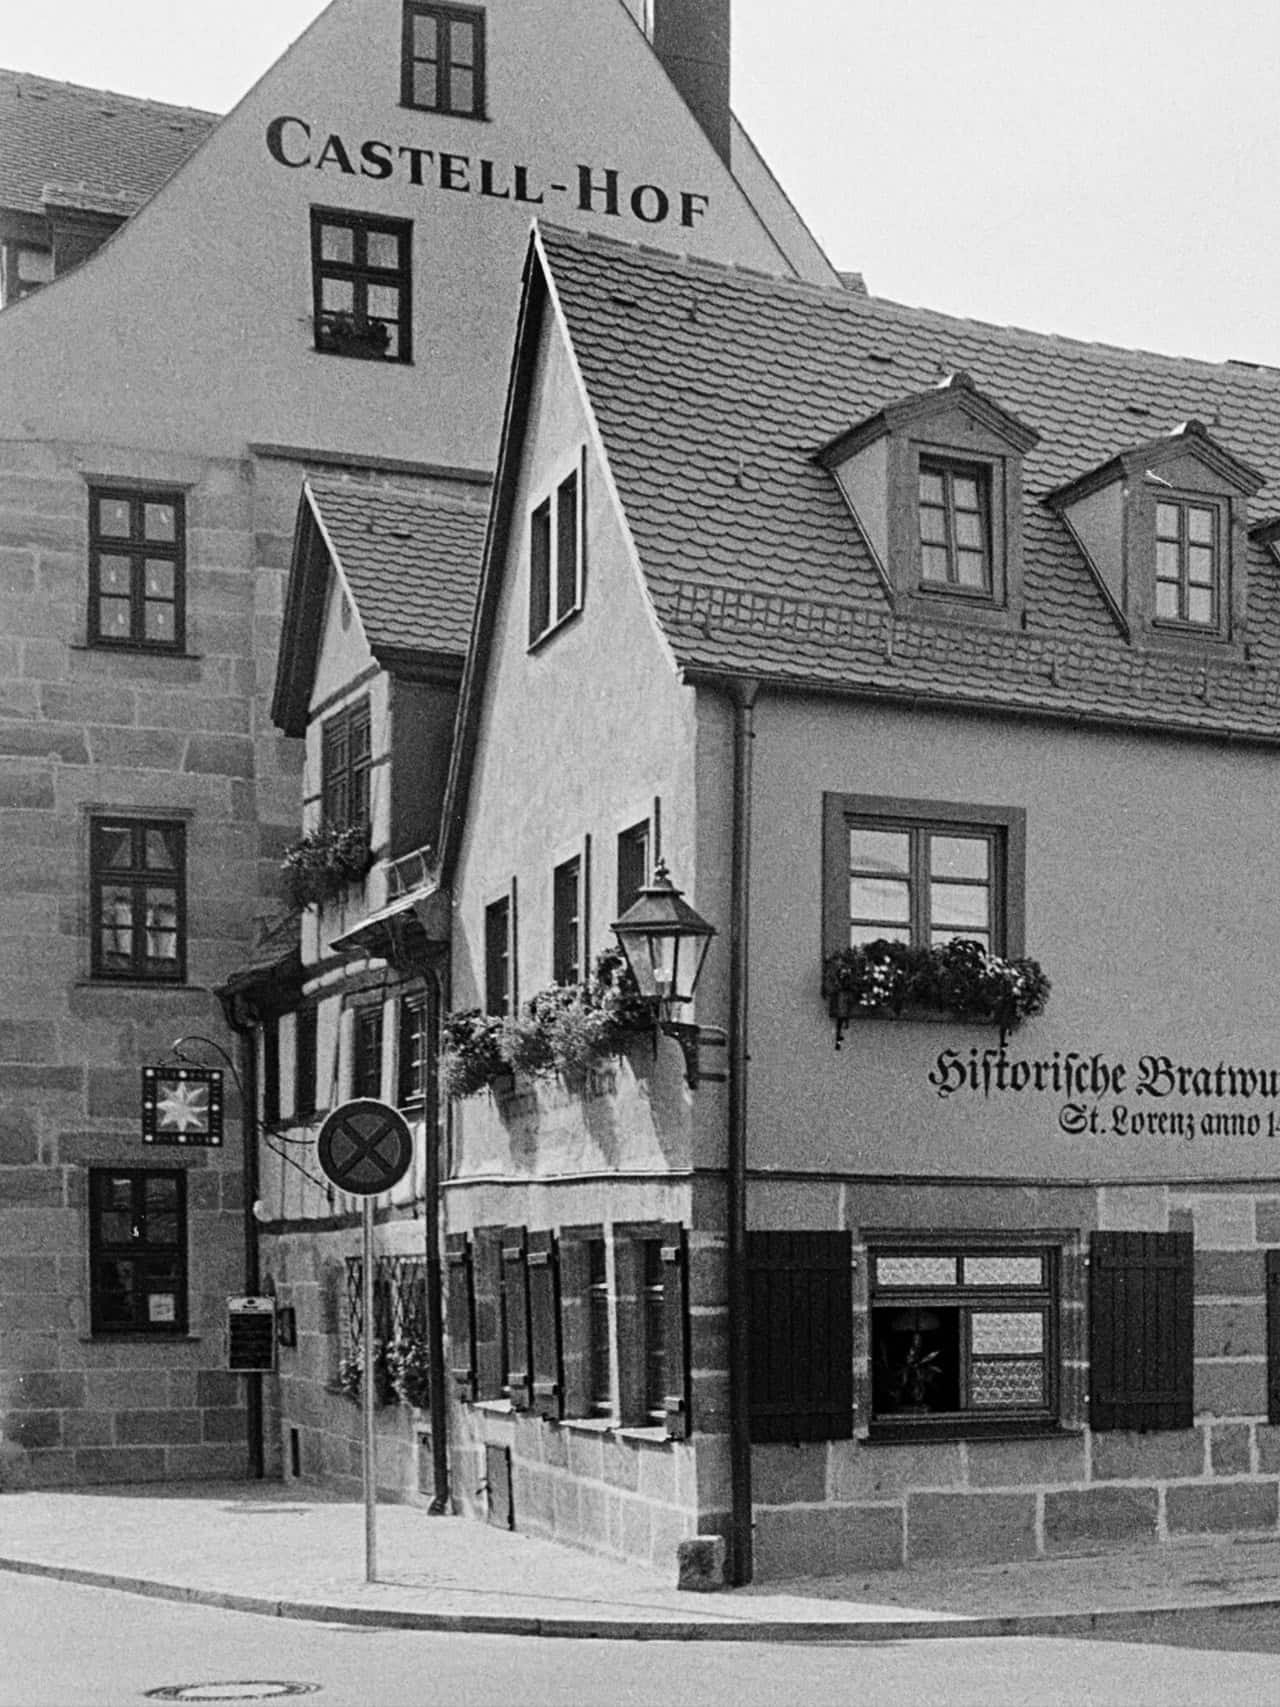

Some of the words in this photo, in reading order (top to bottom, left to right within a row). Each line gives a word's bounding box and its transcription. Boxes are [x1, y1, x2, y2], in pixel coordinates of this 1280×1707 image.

[1058, 1103, 1107, 1136] St.
[1111, 1104, 1194, 1141] Lorenz
[1200, 1109, 1261, 1137] anno
